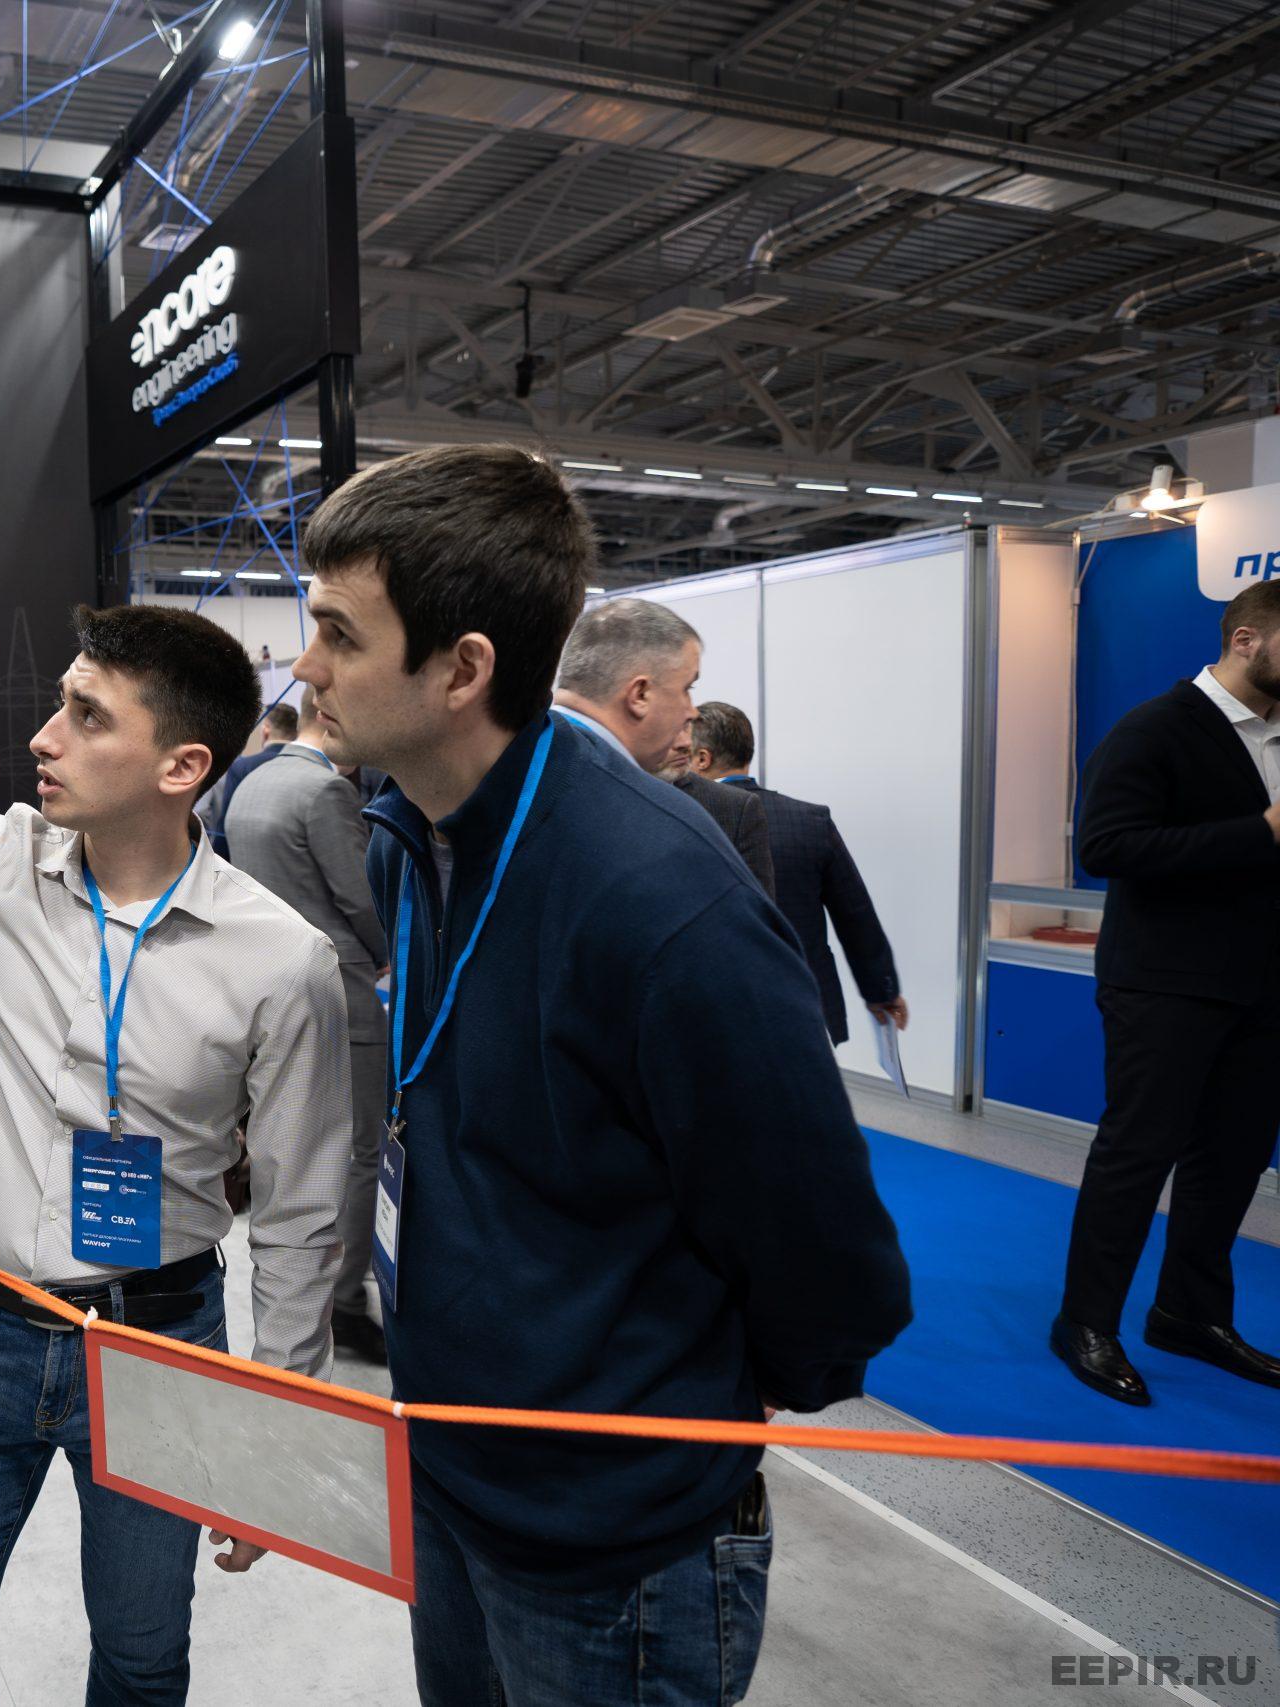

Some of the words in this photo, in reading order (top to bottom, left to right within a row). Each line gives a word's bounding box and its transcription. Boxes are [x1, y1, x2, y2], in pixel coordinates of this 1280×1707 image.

[131, 246, 236, 367] encore
[132, 313, 238, 412] engineering
[82, 1238, 111, 1248] WAVIOT
